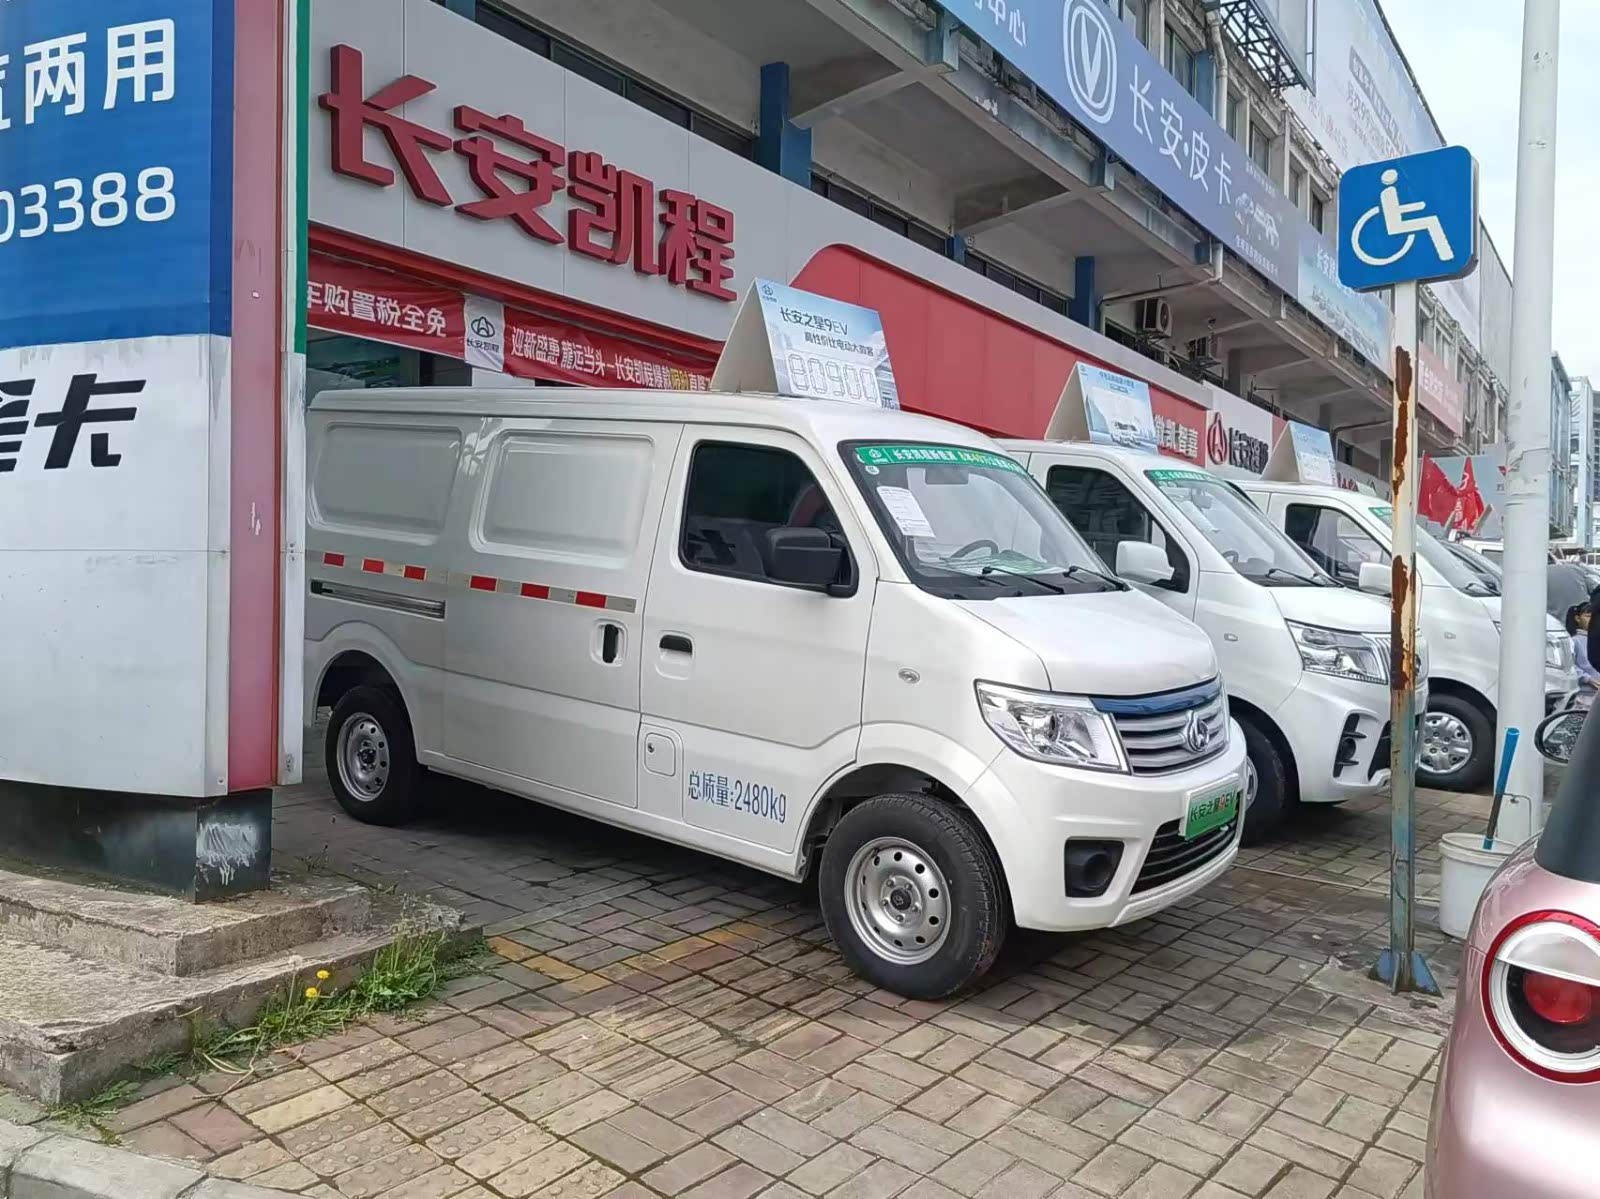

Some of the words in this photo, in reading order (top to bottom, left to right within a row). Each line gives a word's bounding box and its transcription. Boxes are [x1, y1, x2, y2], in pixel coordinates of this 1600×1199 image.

[318, 44, 738, 302] 长安凯程
[510, 326, 560, 364] 迎新盛惠
